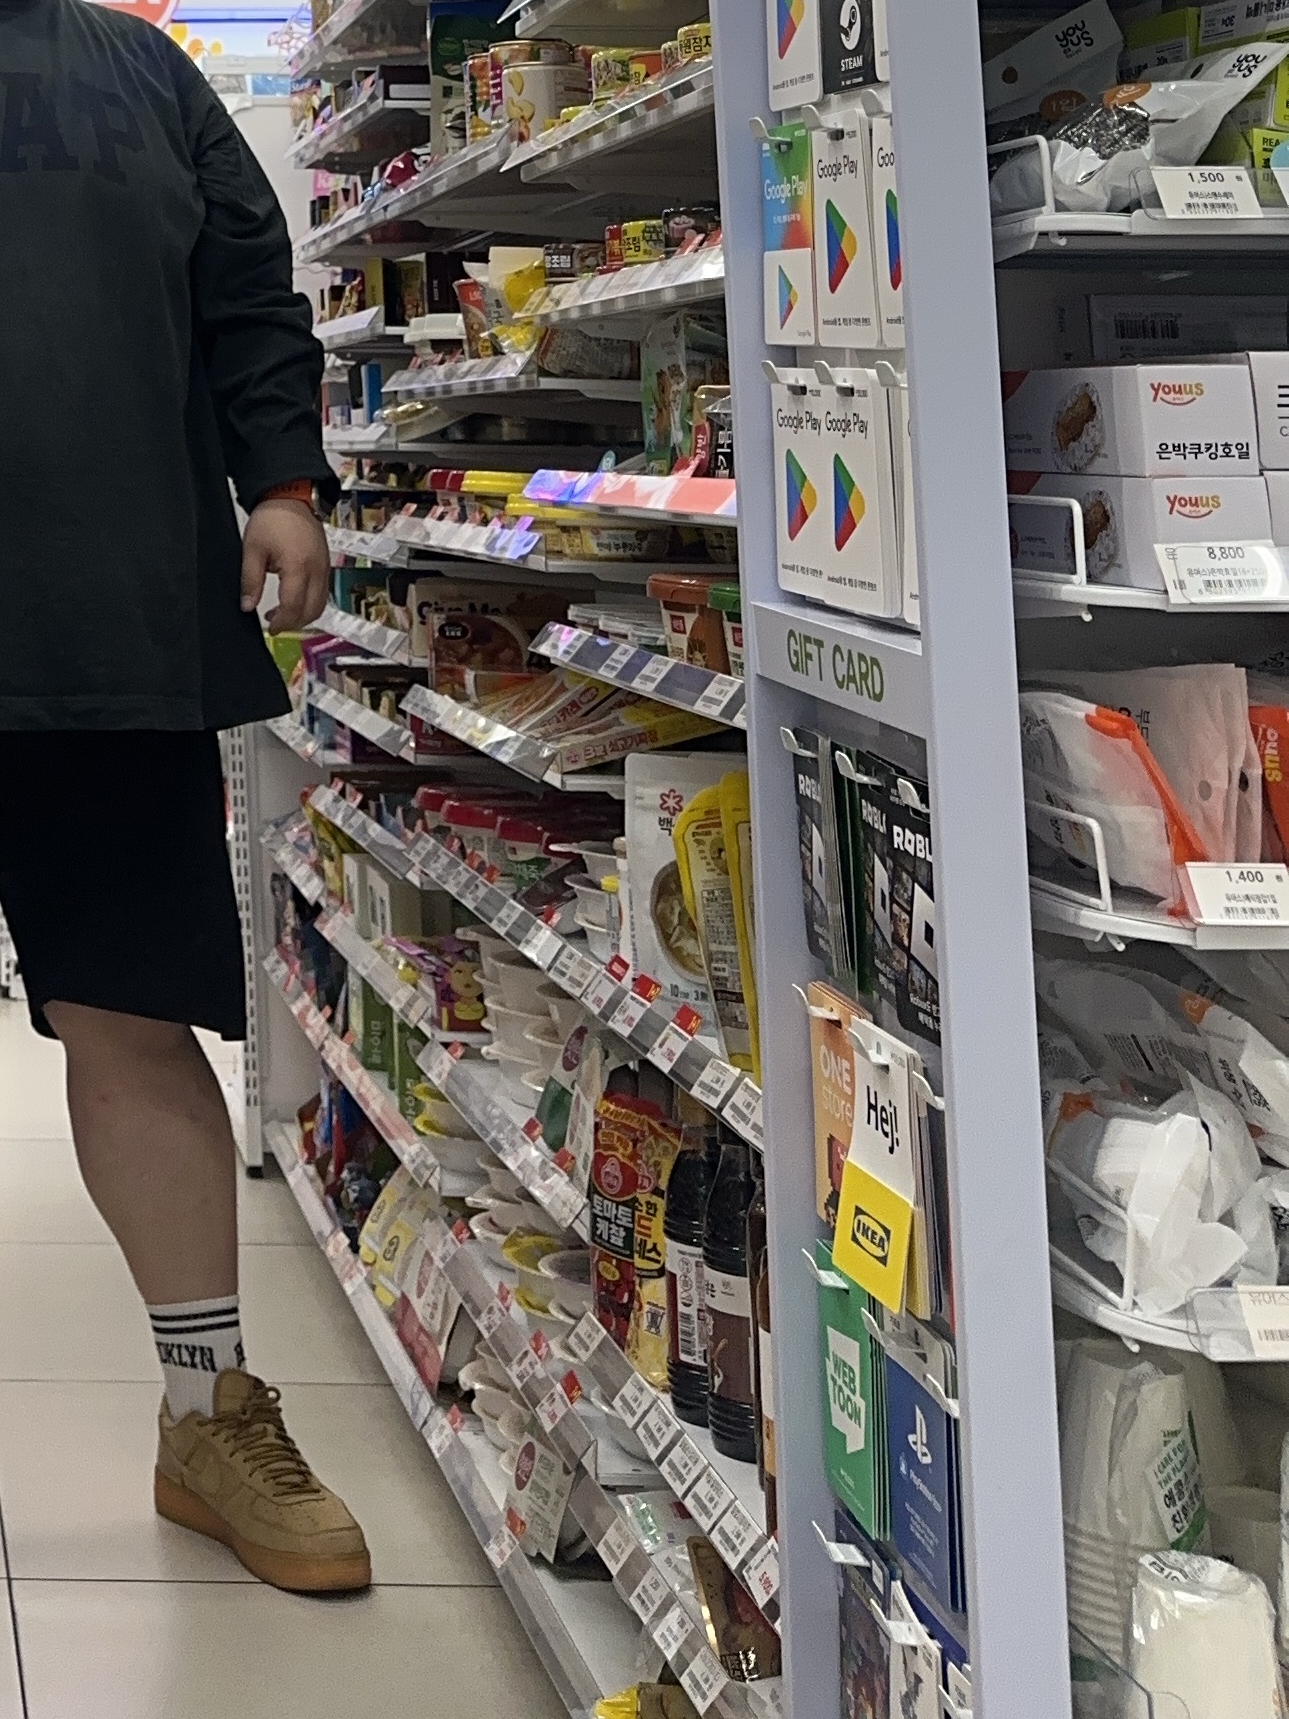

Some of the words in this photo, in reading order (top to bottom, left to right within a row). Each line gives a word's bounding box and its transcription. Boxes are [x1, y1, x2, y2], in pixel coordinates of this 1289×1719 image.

[840, 55, 863, 72] STEAM
[817, 159, 843, 182] Google
[843, 155, 858, 179] Play
[1188, 173, 1225, 185] 1,500
[764, 178, 791, 203] Google
[791, 175, 808, 201] Play
[1150, 382, 1205, 401] youus
[776, 408, 804, 434] Google
[805, 411, 821, 436] Play
[825, 410, 852, 438] Google
[853, 412, 868, 439] Play
[1156, 442, 1251, 460] 은박쿠킹호일
[1166, 494, 1222, 515] youus
[1207, 546, 1245, 560] 8,800
[786, 628, 825, 682] GIFT
[832, 649, 884, 703] CARD
[1225, 870, 1264, 884] 1,400
[819, 1044, 852, 1096] ONE
[821, 1088, 853, 1128] store
[866, 1085, 900, 1155] Hej!
[592, 1197, 632, 1228] 토마토
[595, 1220, 627, 1249] 케찹
[856, 1218, 887, 1254] IKEA
[831, 1349, 857, 1393] WEB
[830, 1378, 862, 1429] TOON
